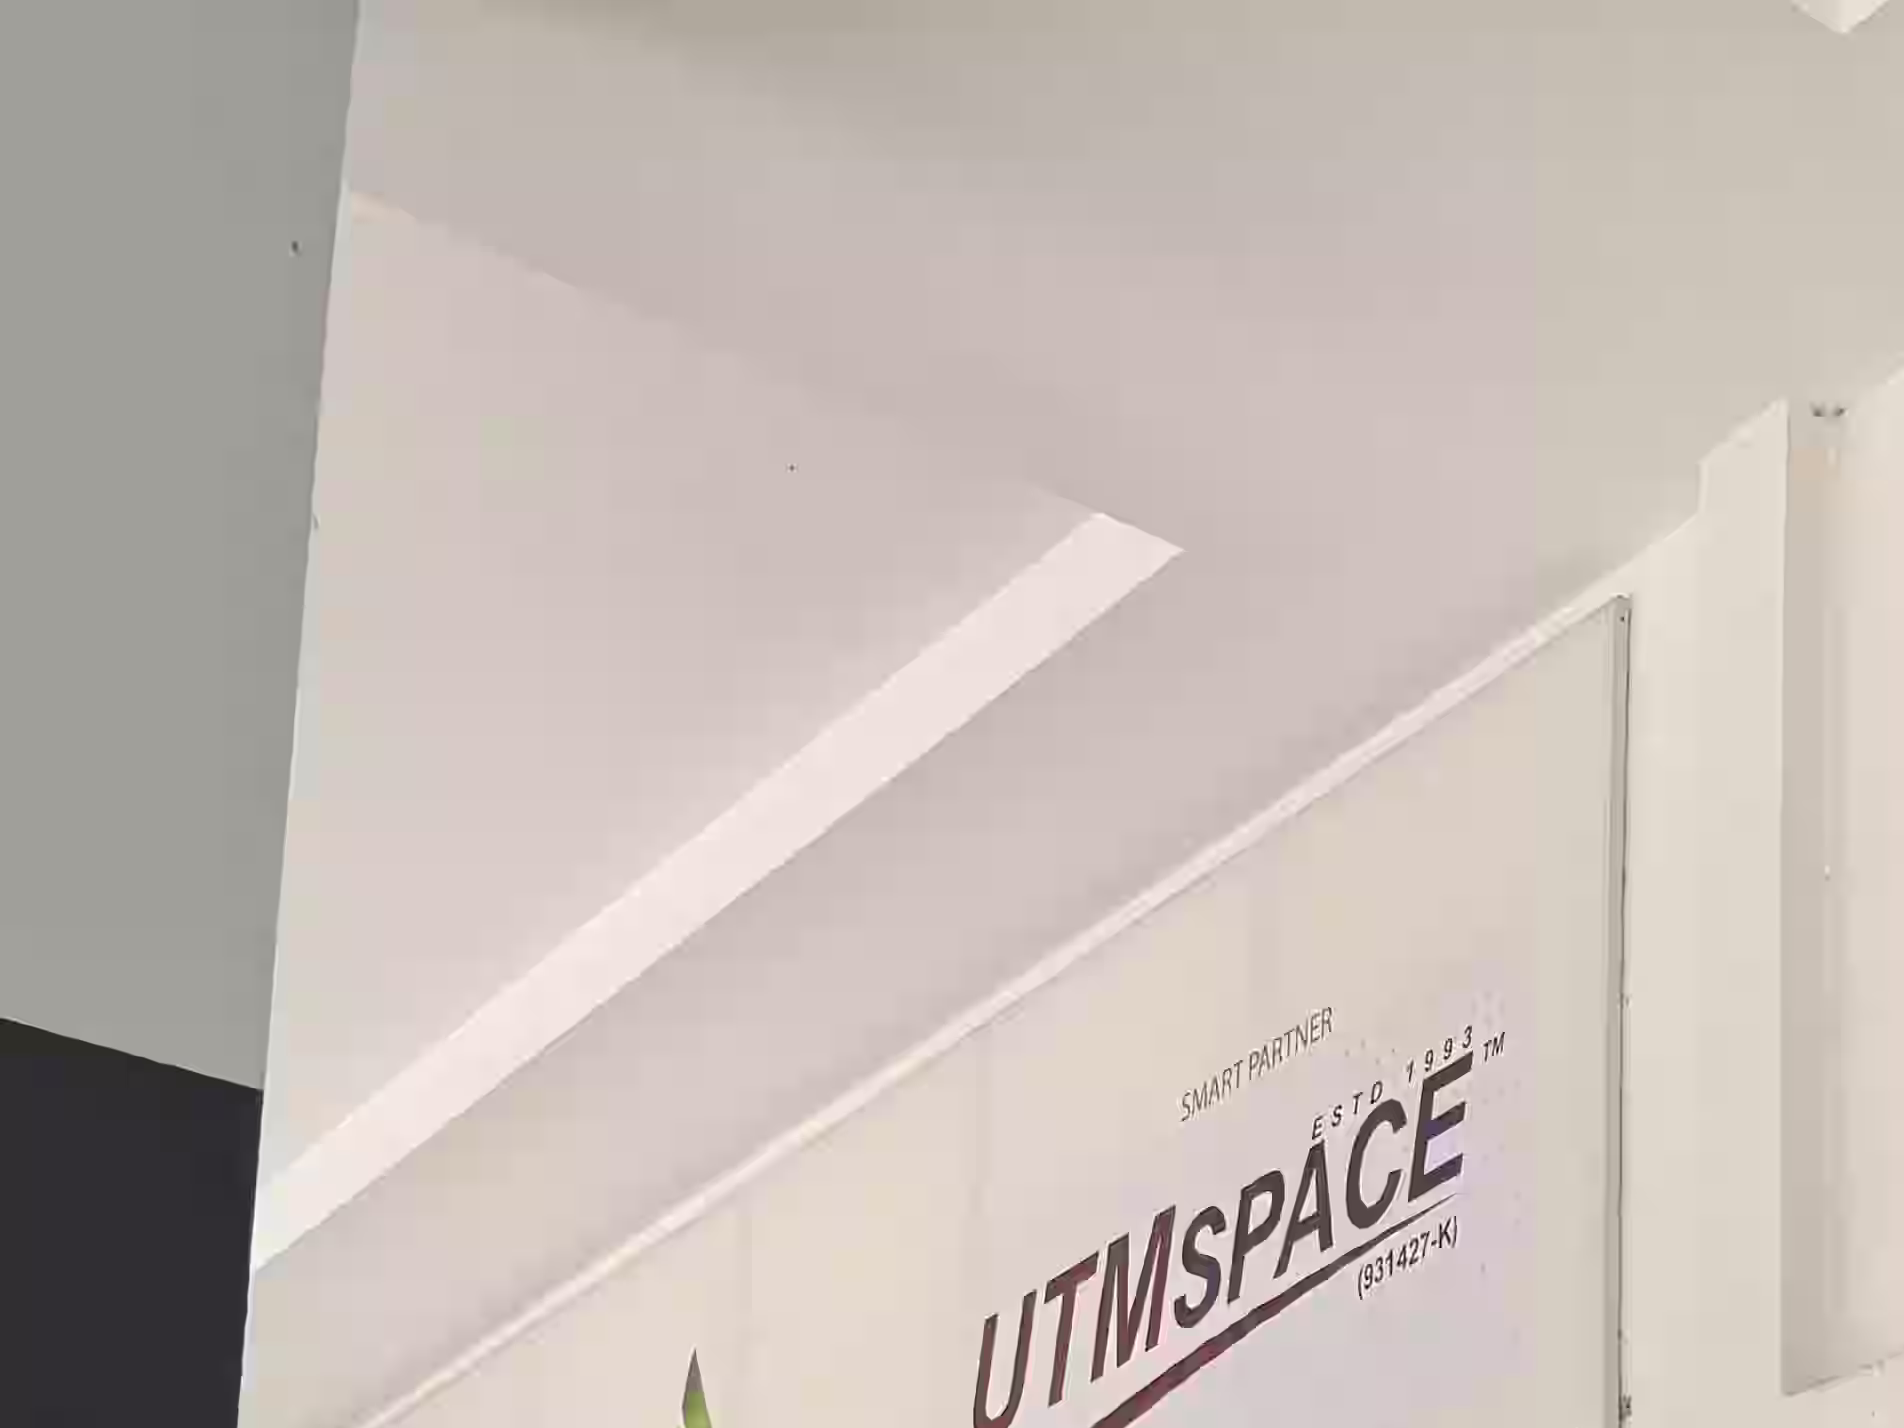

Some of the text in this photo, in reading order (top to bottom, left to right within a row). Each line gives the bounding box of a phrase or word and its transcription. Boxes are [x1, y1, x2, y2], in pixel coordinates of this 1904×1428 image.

[1181, 1005, 1332, 1122] SMART PARTNER
[1311, 1024, 1473, 1140] ESTD 1993
[1357, 1215, 1459, 1300] (931427-K)
